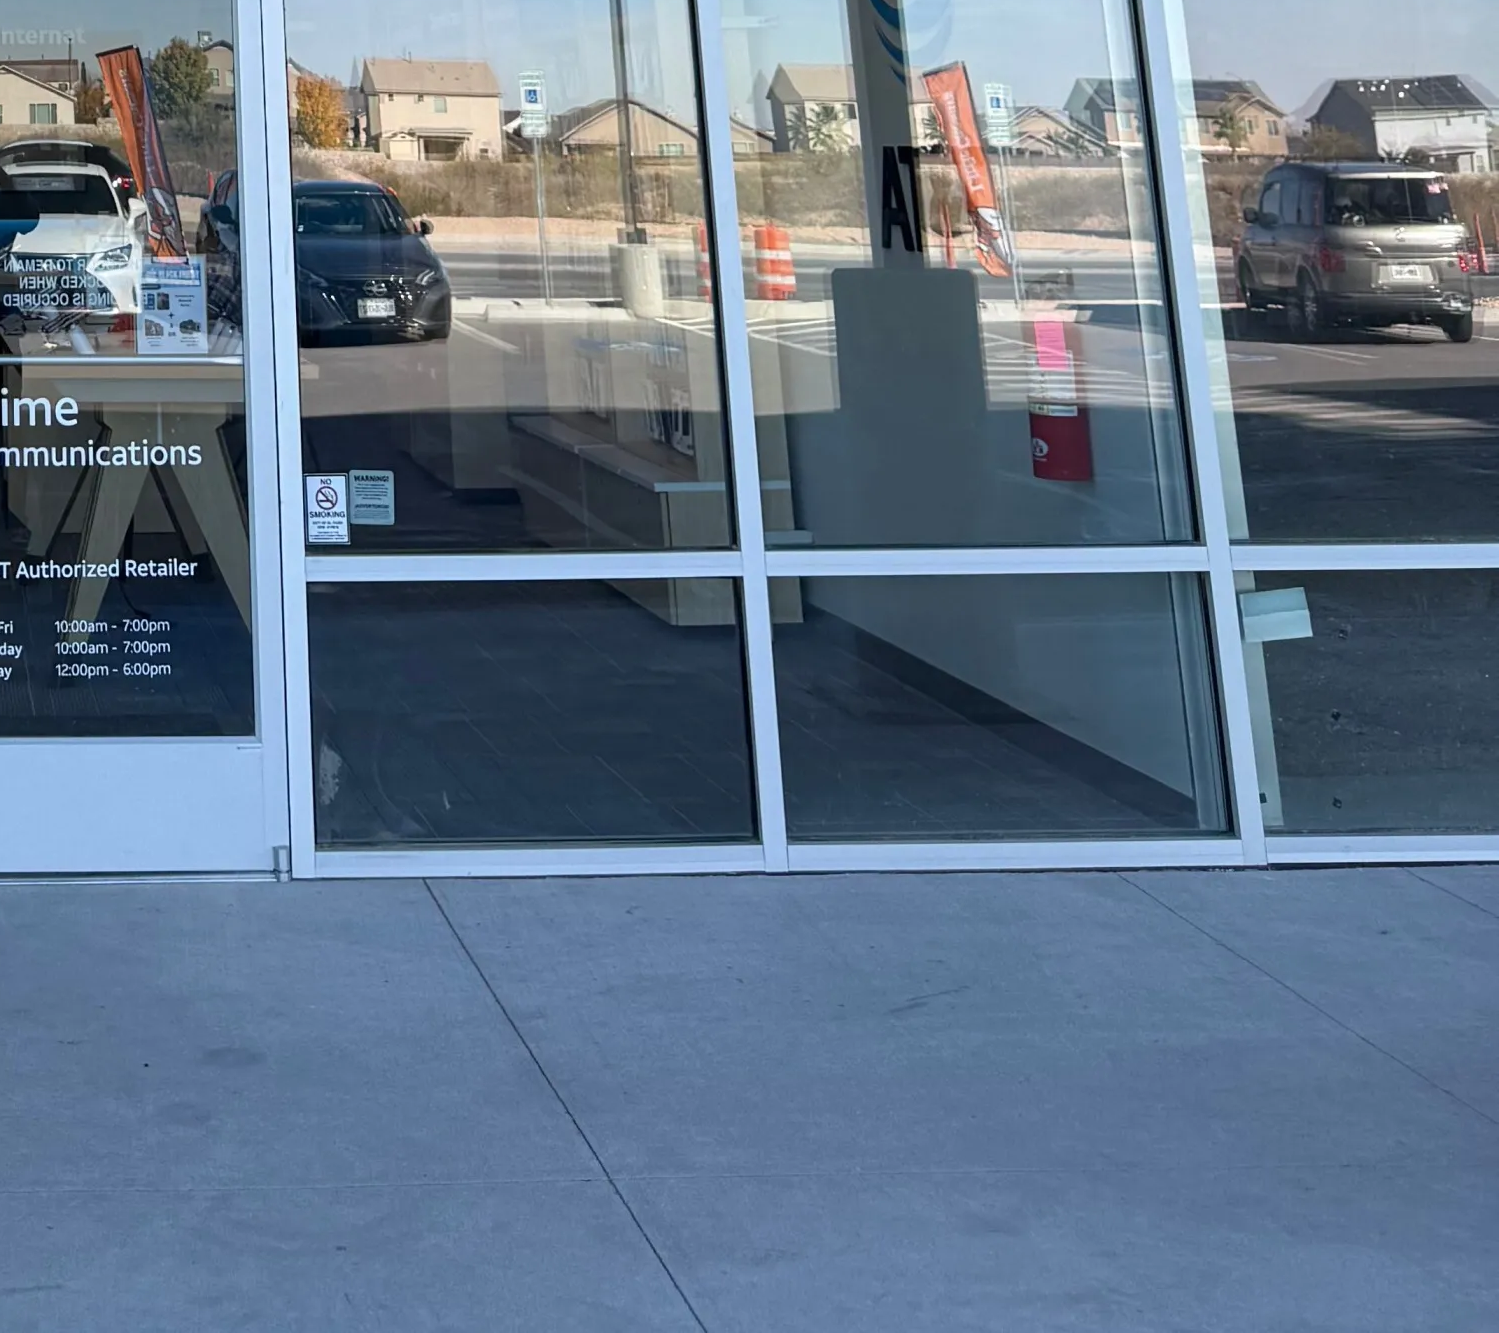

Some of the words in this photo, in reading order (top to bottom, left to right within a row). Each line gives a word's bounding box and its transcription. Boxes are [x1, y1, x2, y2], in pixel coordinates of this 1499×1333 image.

[15, 558, 121, 580] Authorized
[125, 558, 198, 578] Retailer
[54, 619, 108, 634] 10:00am
[123, 619, 170, 635] 7:00pm
[55, 640, 109, 655] 10:00am
[123, 640, 171, 657] 7:00pm
[55, 662, 109, 679] 12:00pm
[123, 662, 171, 678] 6:00pm
